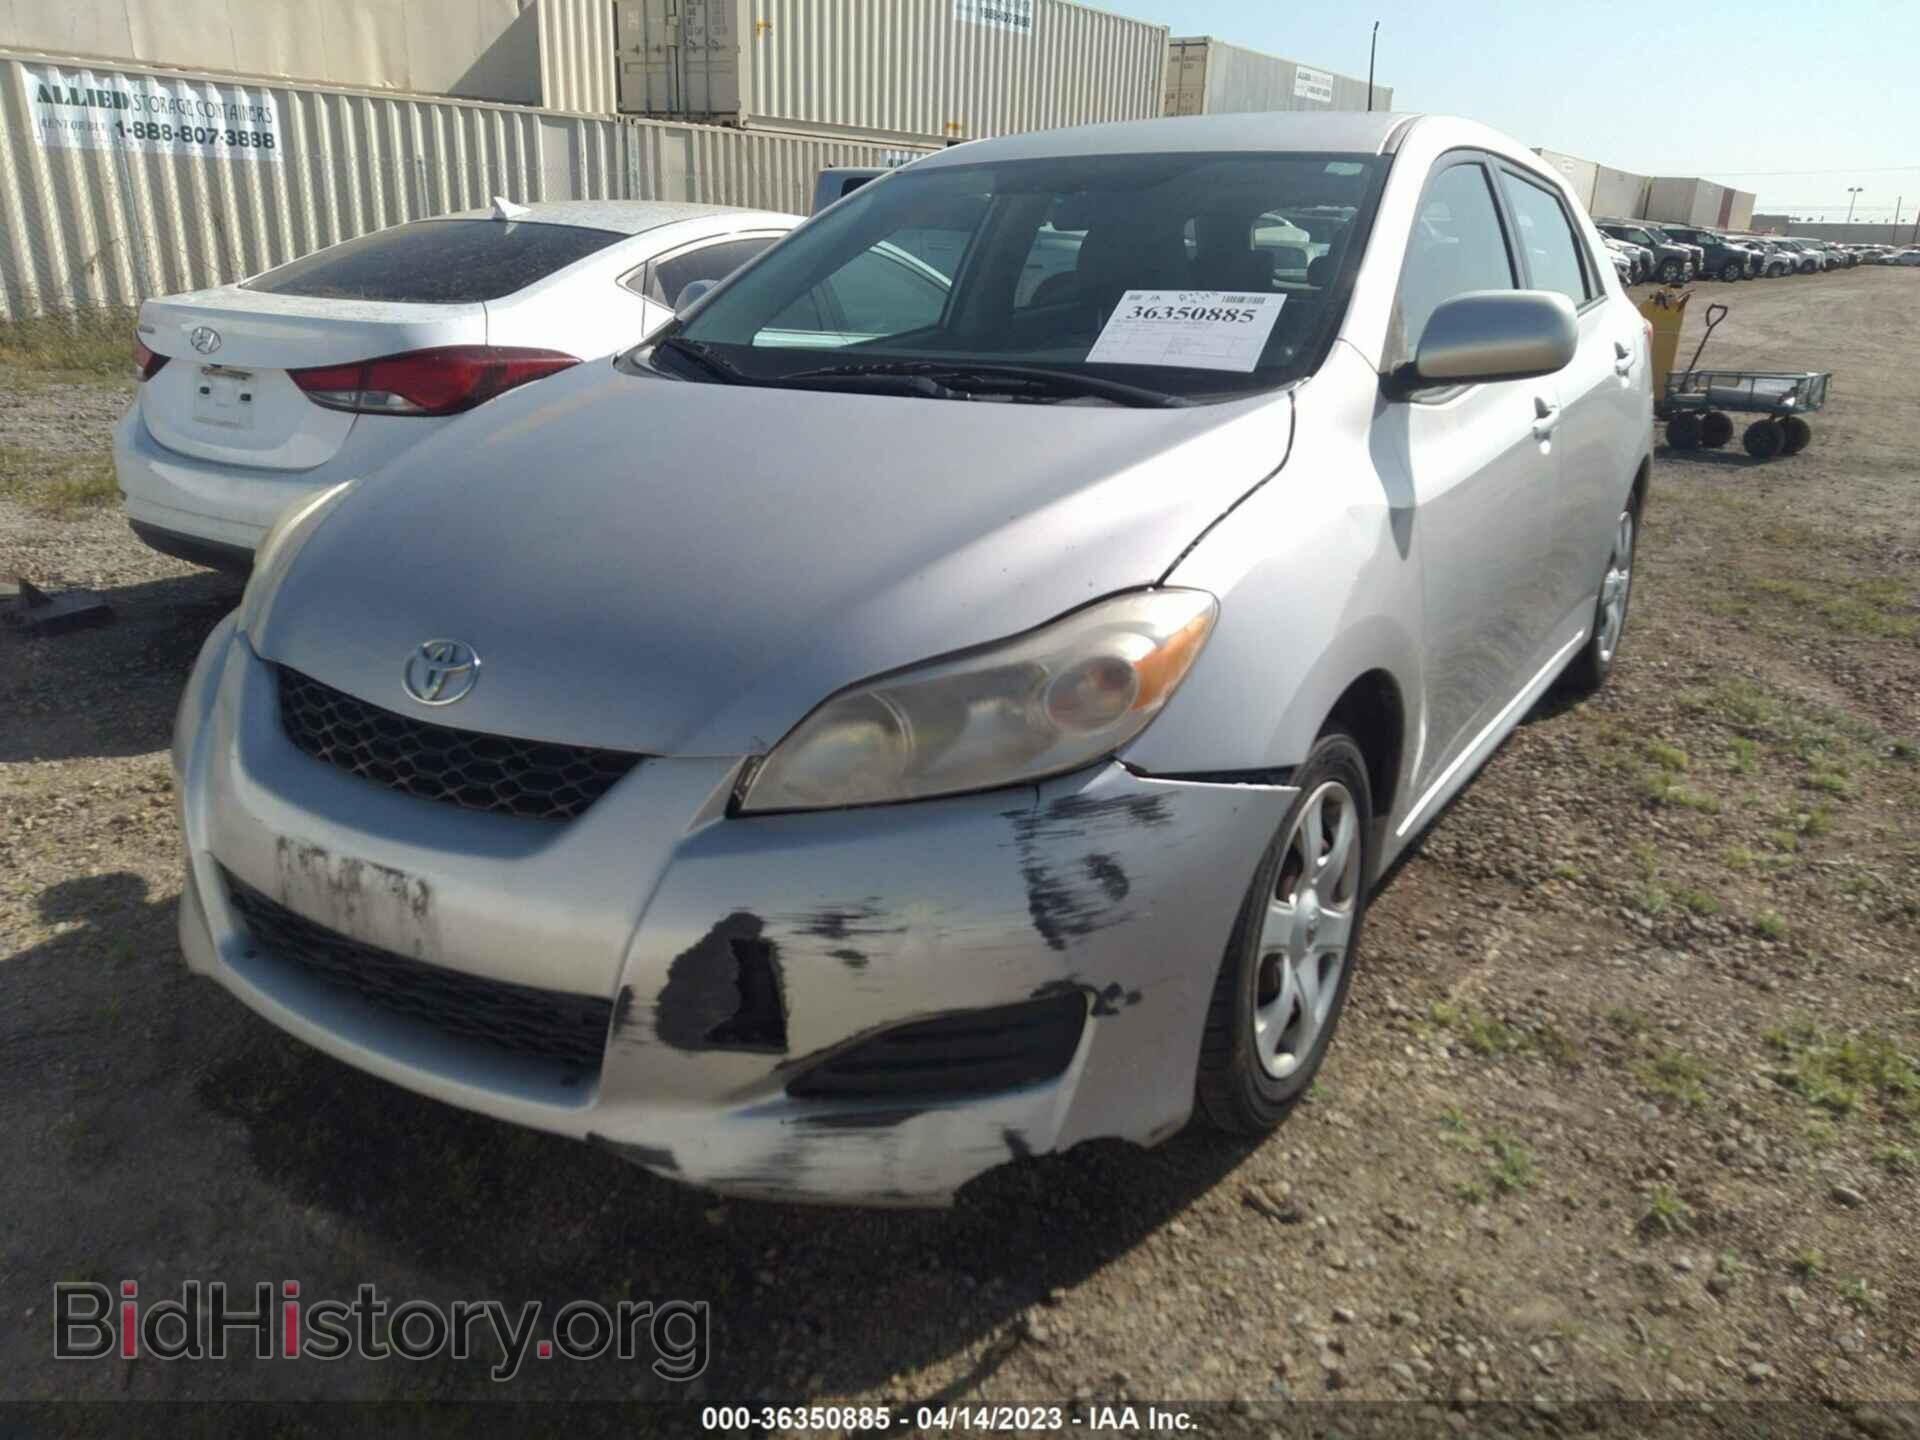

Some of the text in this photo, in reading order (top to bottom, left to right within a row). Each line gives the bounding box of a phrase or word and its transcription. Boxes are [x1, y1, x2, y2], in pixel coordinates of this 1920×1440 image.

[37, 83, 130, 110] ALLIED
[133, 94, 194, 117] STORAGE
[115, 120, 275, 149] 1-888-807-3888
[1126, 305, 1257, 323] 36350885
